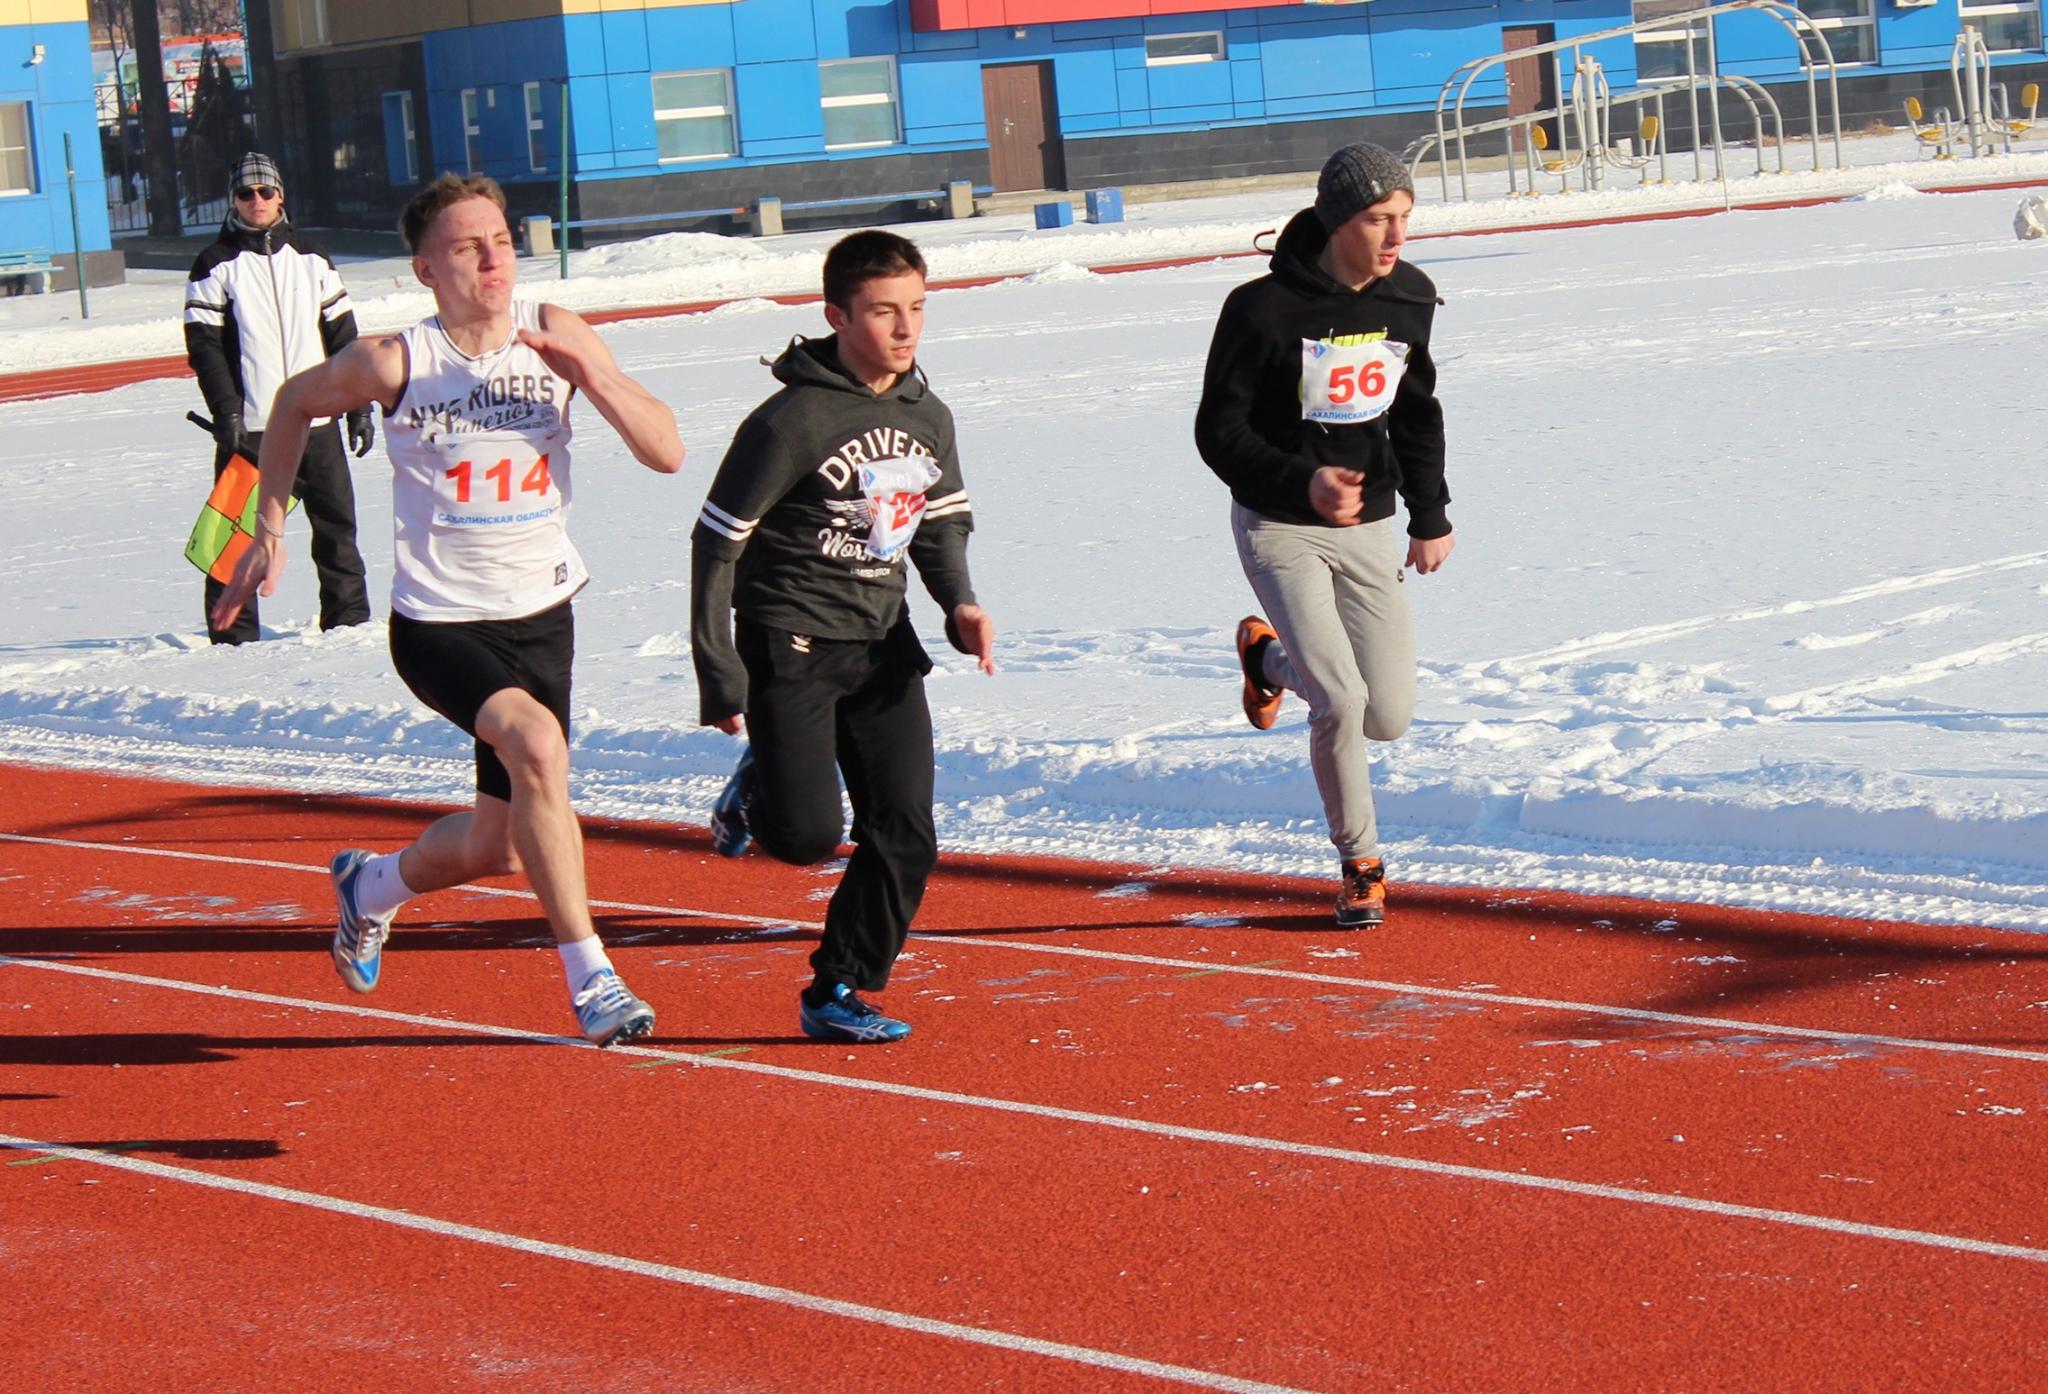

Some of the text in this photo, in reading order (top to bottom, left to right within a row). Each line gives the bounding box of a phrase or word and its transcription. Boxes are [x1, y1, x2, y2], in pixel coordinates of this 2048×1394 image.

[410, 374, 555, 430] NY RIDERS
[1328, 360, 1386, 404] 56
[445, 453, 551, 502] 114
[818, 427, 935, 491] DRIVER
[438, 512, 513, 525] САХАЛИНСКАЯ
